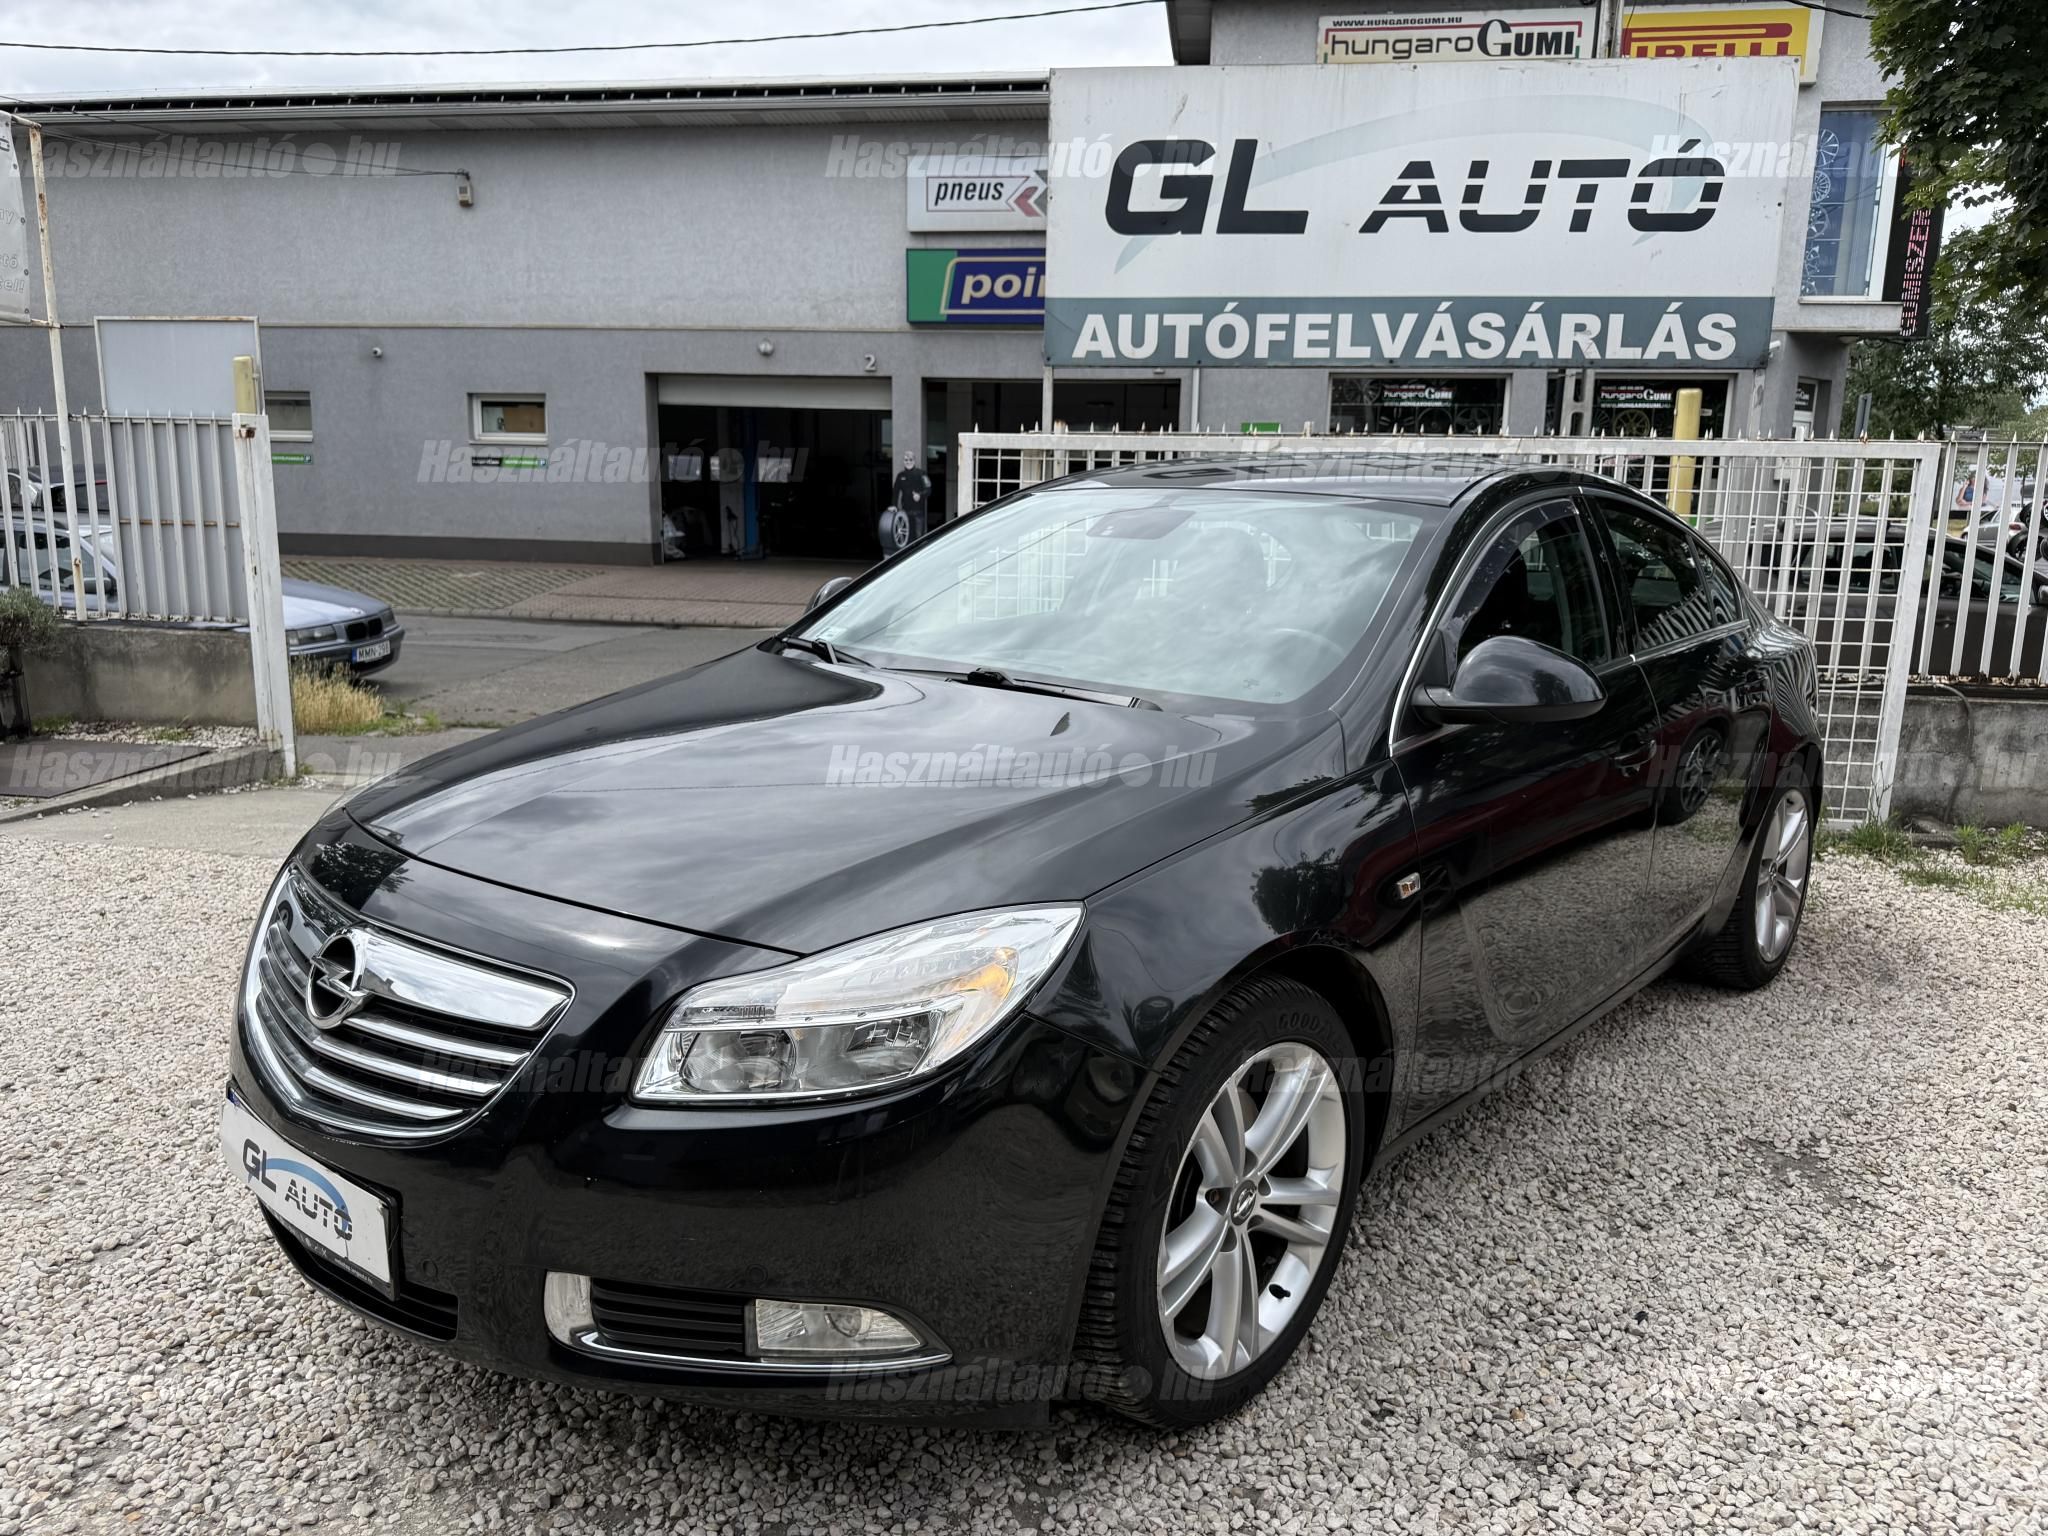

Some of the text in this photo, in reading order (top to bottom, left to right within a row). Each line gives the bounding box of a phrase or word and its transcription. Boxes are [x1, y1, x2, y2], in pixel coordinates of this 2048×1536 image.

[1332, 16, 1463, 28] WWW.HUNGAROGUMI.HU
[934, 181, 1005, 206] pneus
[1106, 138, 1727, 236] GL AUTÓ
[1900, 207, 1932, 337] GUMISZER
[1072, 301, 1738, 360] AUTÓFELVÁSÁRLÁS
[865, 354, 877, 372] 2
[242, 1138, 277, 1193] GL
